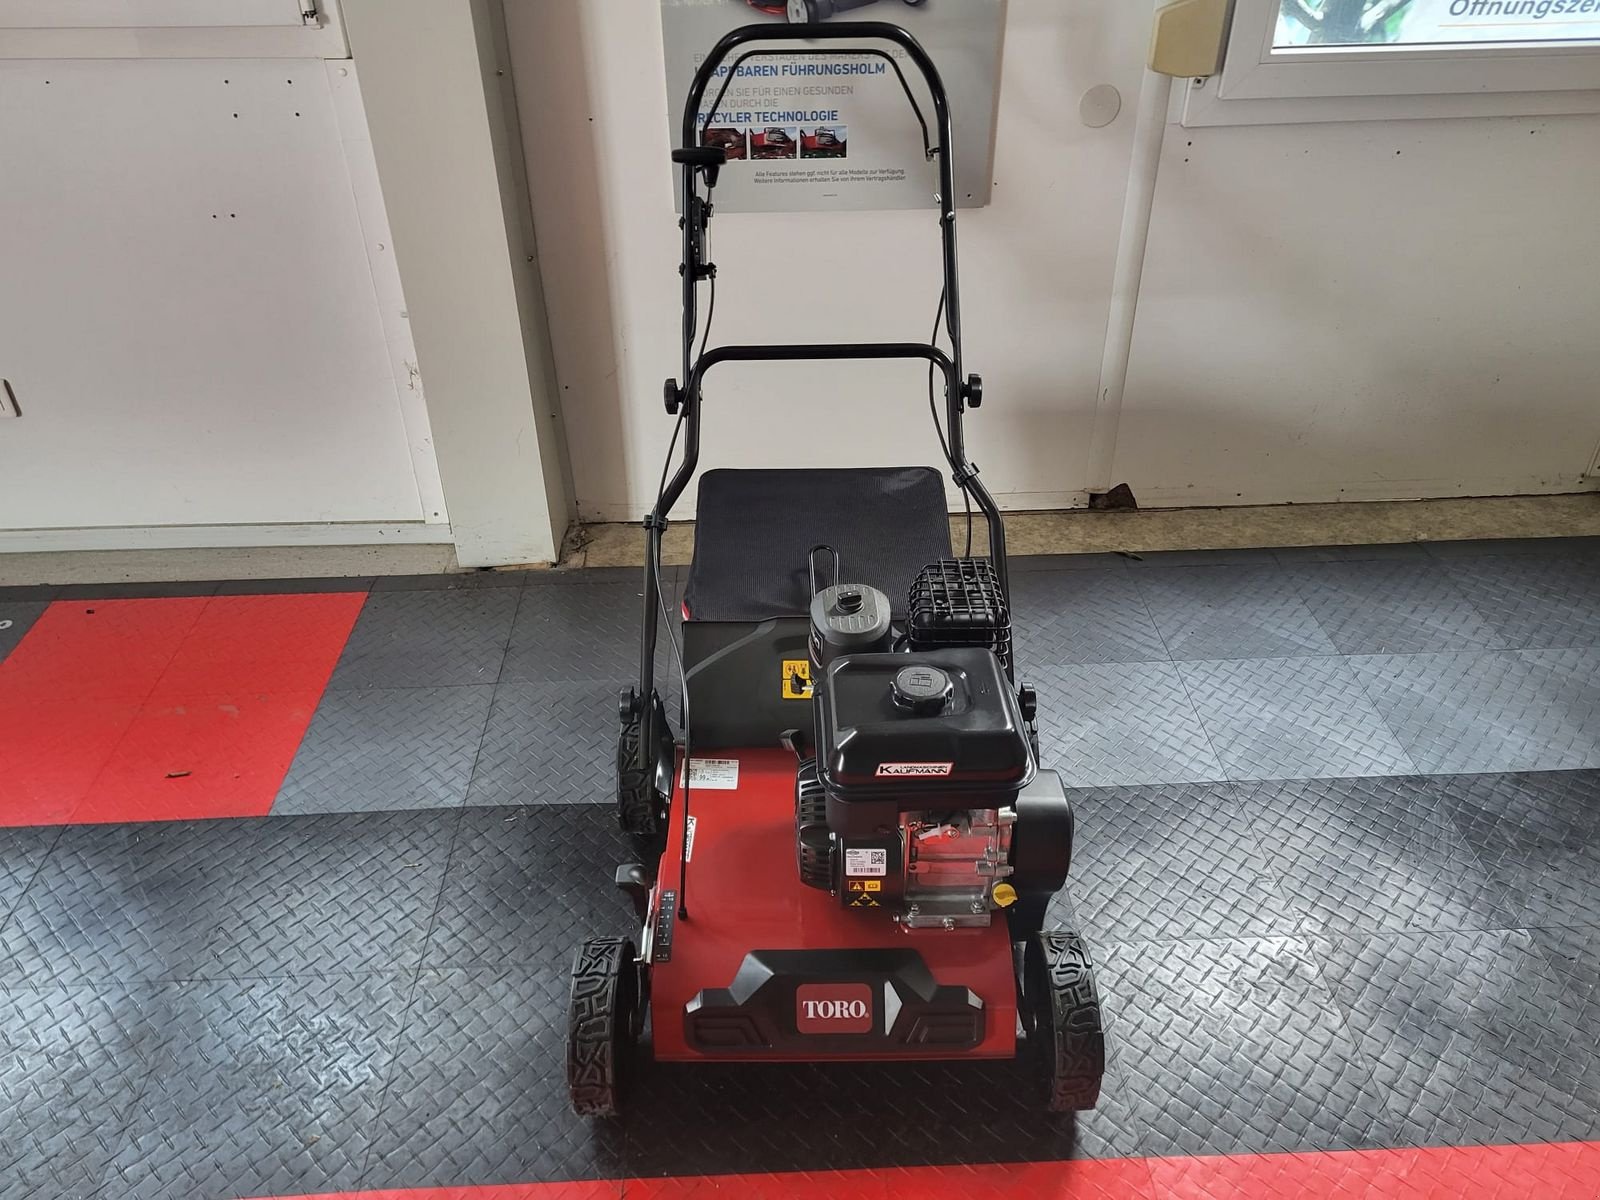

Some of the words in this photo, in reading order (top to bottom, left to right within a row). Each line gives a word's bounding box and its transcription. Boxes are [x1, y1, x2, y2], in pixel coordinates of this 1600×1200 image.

[892, 50, 907, 59] DE
[695, 65, 778, 77] APBAREN
[782, 62, 886, 77] FÜHRUNGSHOLM
[736, 87, 750, 97] SIE
[753, 85, 771, 96] FÜR
[774, 86, 801, 96] EINEN
[803, 85, 854, 96] GESUNDEN
[730, 99, 761, 108] DURCH
[764, 98, 779, 108] DIE
[754, 110, 838, 123] TECHNOLOGIE
[880, 765, 947, 774] KAUFMANN
[803, 1000, 867, 1018] TORO
